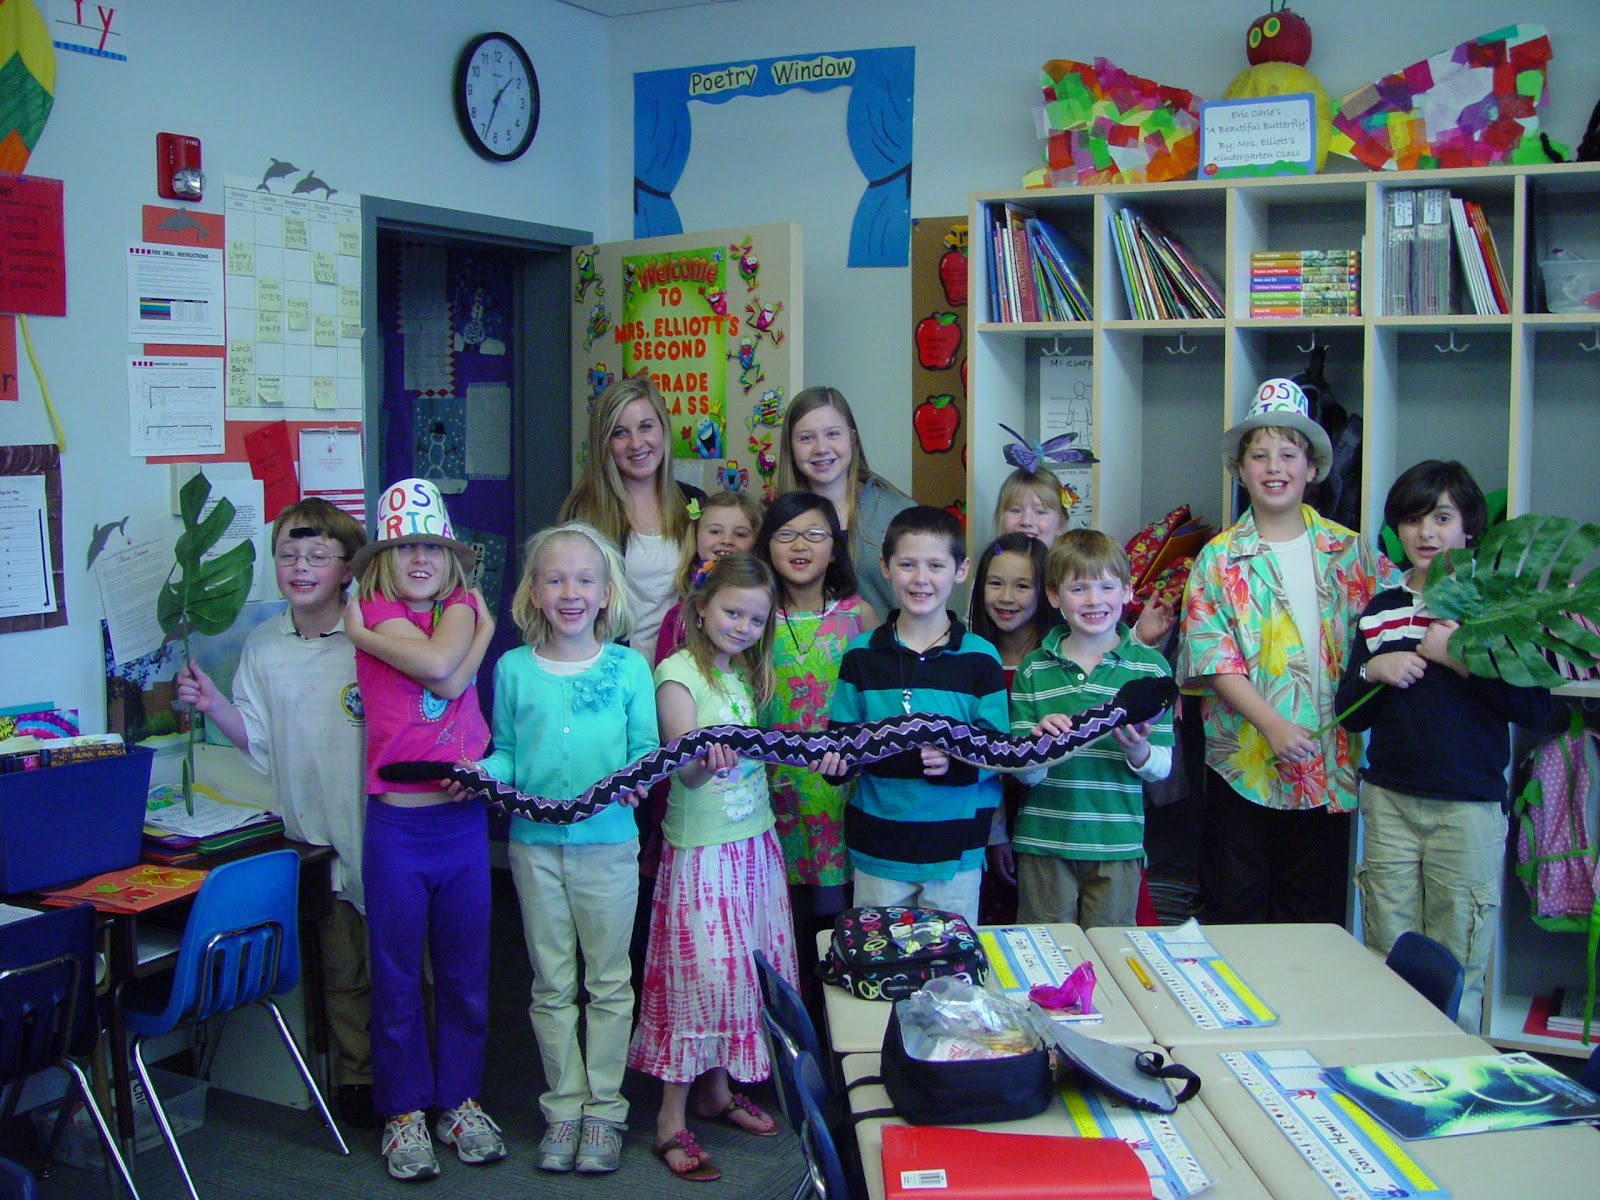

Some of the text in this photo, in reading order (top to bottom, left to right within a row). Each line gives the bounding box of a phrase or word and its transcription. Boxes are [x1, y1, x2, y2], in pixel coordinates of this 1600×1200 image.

[482, 53, 488, 65] 11
[494, 52, 502, 63] 12
[472, 66, 480, 78] 10
[509, 61, 512, 73] 1
[691, 56, 852, 94] Poetry Window
[516, 78, 522, 89] 2
[468, 84, 472, 96] 9
[520, 98, 525, 110] 3
[471, 107, 476, 118] 8
[1232, 108, 1280, 119] Eric Carle's
[481, 124, 486, 136] 7
[515, 120, 520, 128] 4
[1220, 122, 1260, 133] Beautiful
[493, 133, 498, 144] 6
[506, 130, 512, 140] 5
[186, 139, 198, 147] FIRE
[1219, 142, 1234, 152] By:
[1261, 138, 1295, 146] Elliott's
[1214, 152, 1272, 162] Kindergarten
[177, 252, 210, 260] INSTRUCTIONS
[636, 253, 719, 292] Welcome
[658, 286, 682, 307] TO
[614, 313, 740, 344] MRS. ELLIOTT'S
[230, 343, 251, 352] Lunch
[633, 338, 707, 360] SECOND
[1067, 361, 1093, 372] cuerp
[650, 372, 708, 392] GRADE
[1255, 383, 1306, 416] OSTA
[1312, 1116, 1376, 1174] Gavin Hewitt
